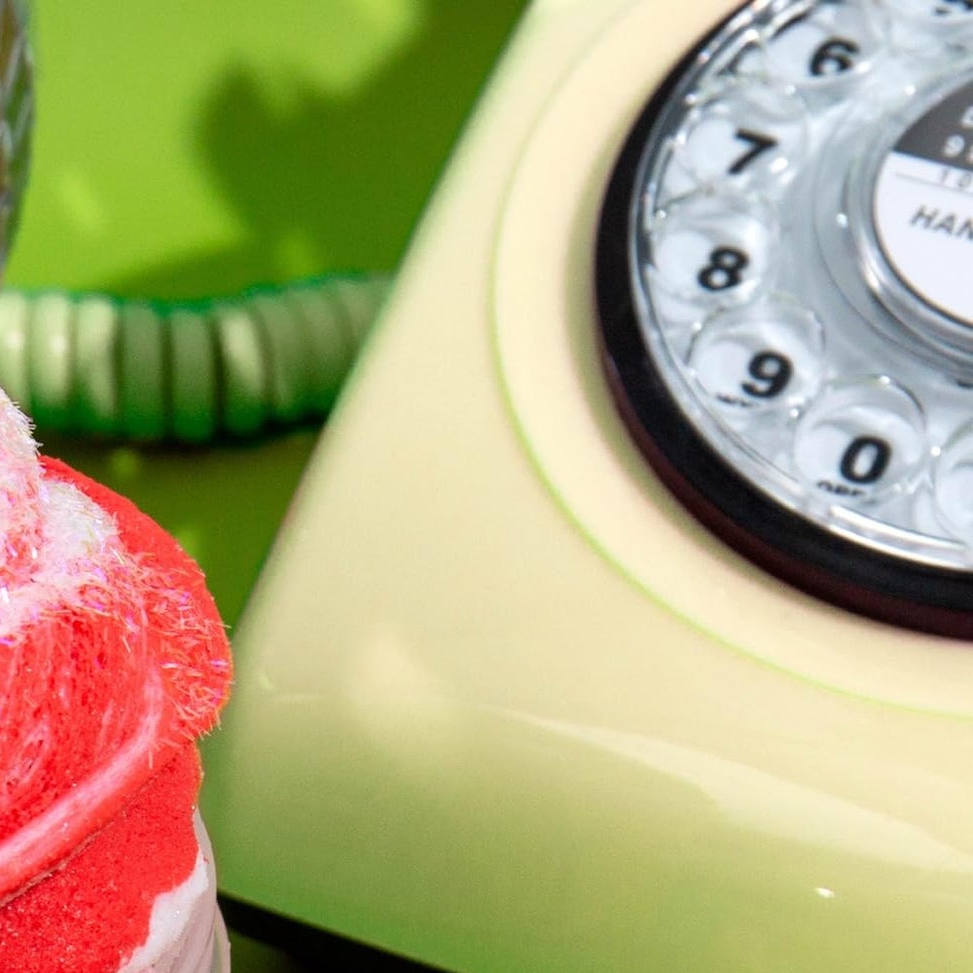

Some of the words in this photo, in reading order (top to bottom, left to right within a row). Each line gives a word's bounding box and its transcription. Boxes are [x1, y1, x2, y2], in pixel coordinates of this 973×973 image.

[810, 36, 861, 77] 6
[728, 128, 778, 175] 7
[698, 246, 749, 292] 8
[742, 351, 792, 399] 9
[840, 434, 893, 484] 0
